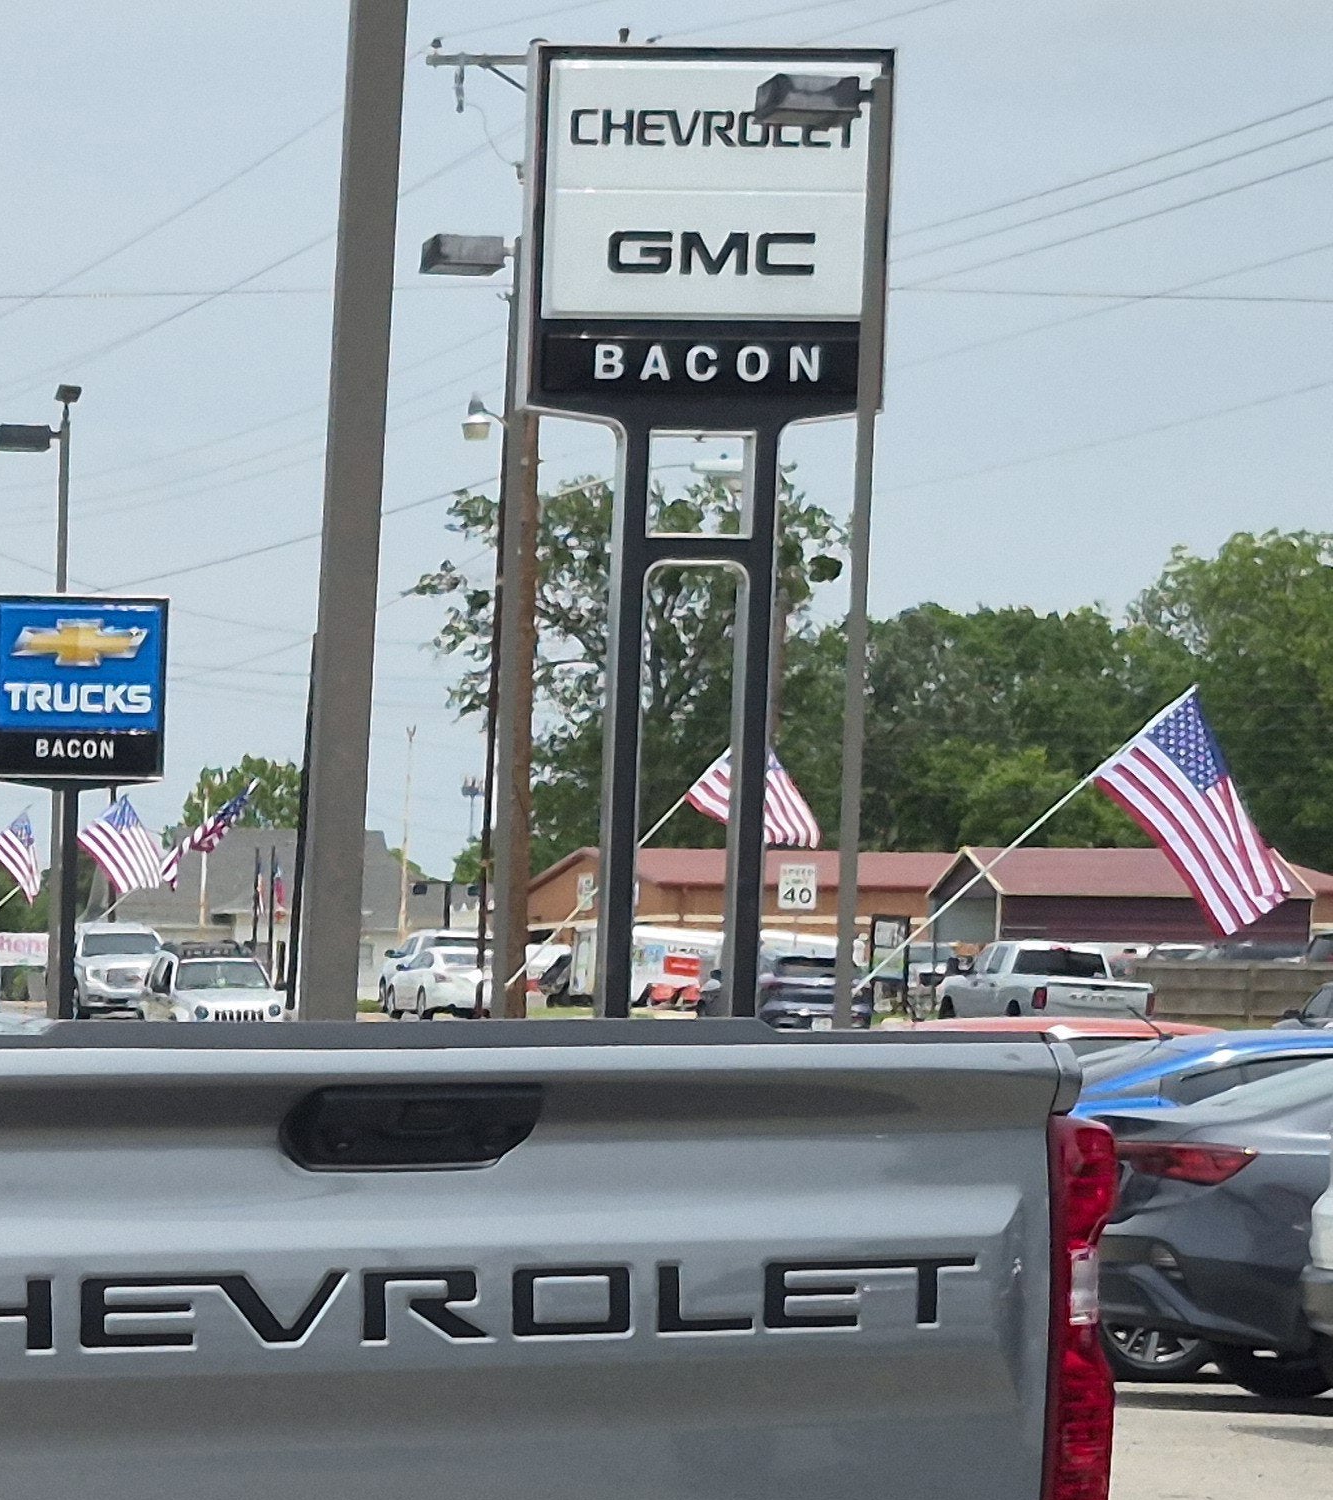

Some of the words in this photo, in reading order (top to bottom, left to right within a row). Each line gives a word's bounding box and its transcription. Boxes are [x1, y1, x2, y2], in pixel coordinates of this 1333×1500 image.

[569, 109, 862, 148] CHEVROLET
[608, 231, 815, 276] GMC
[594, 344, 821, 382] BACON
[4, 682, 151, 713] TRUCKS
[35, 739, 114, 759] BACON
[783, 888, 812, 903] 40
